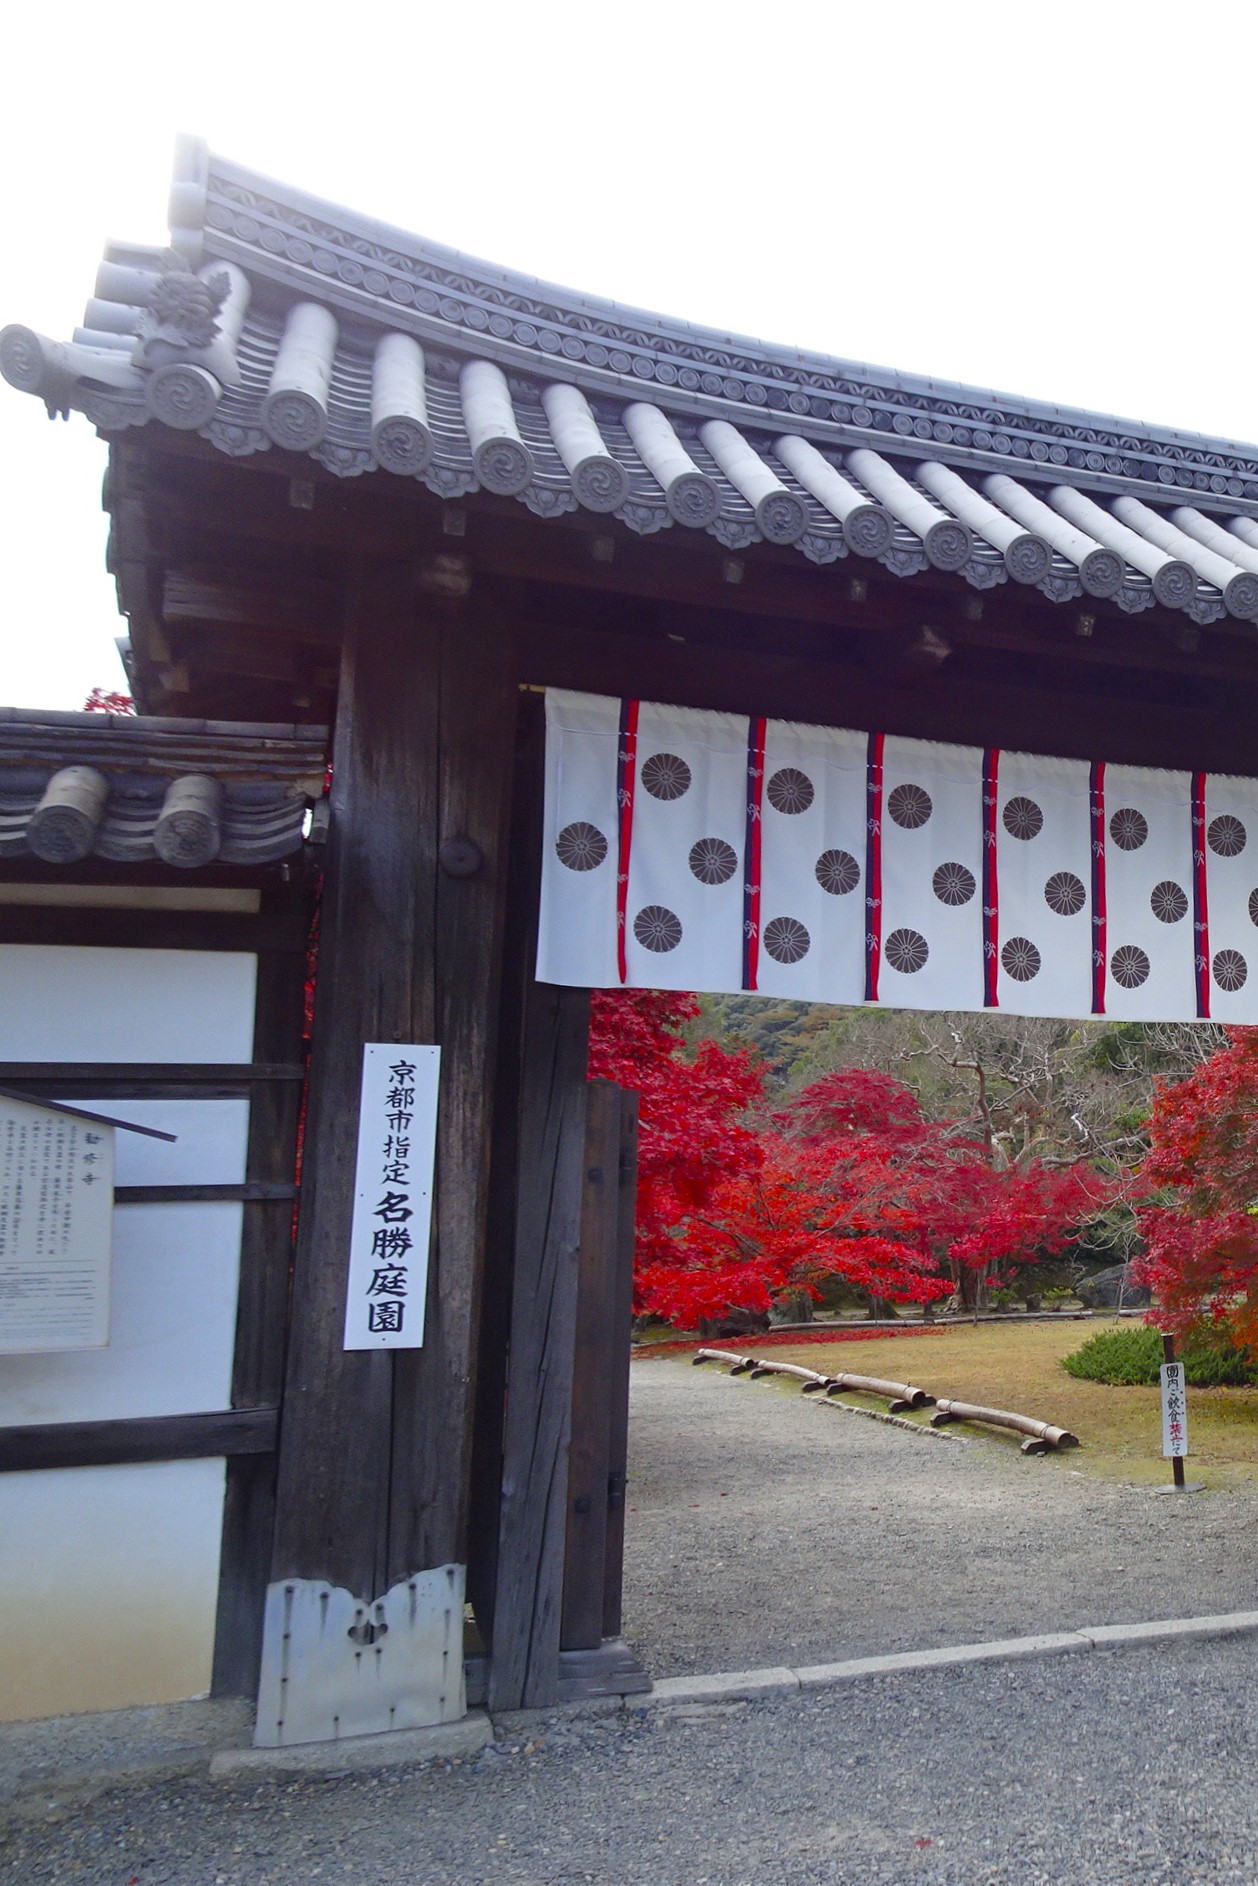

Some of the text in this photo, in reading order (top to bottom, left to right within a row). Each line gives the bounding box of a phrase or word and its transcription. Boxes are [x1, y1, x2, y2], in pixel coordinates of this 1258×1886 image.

[366, 1060, 417, 1333] 京都市指定名勝庭園
